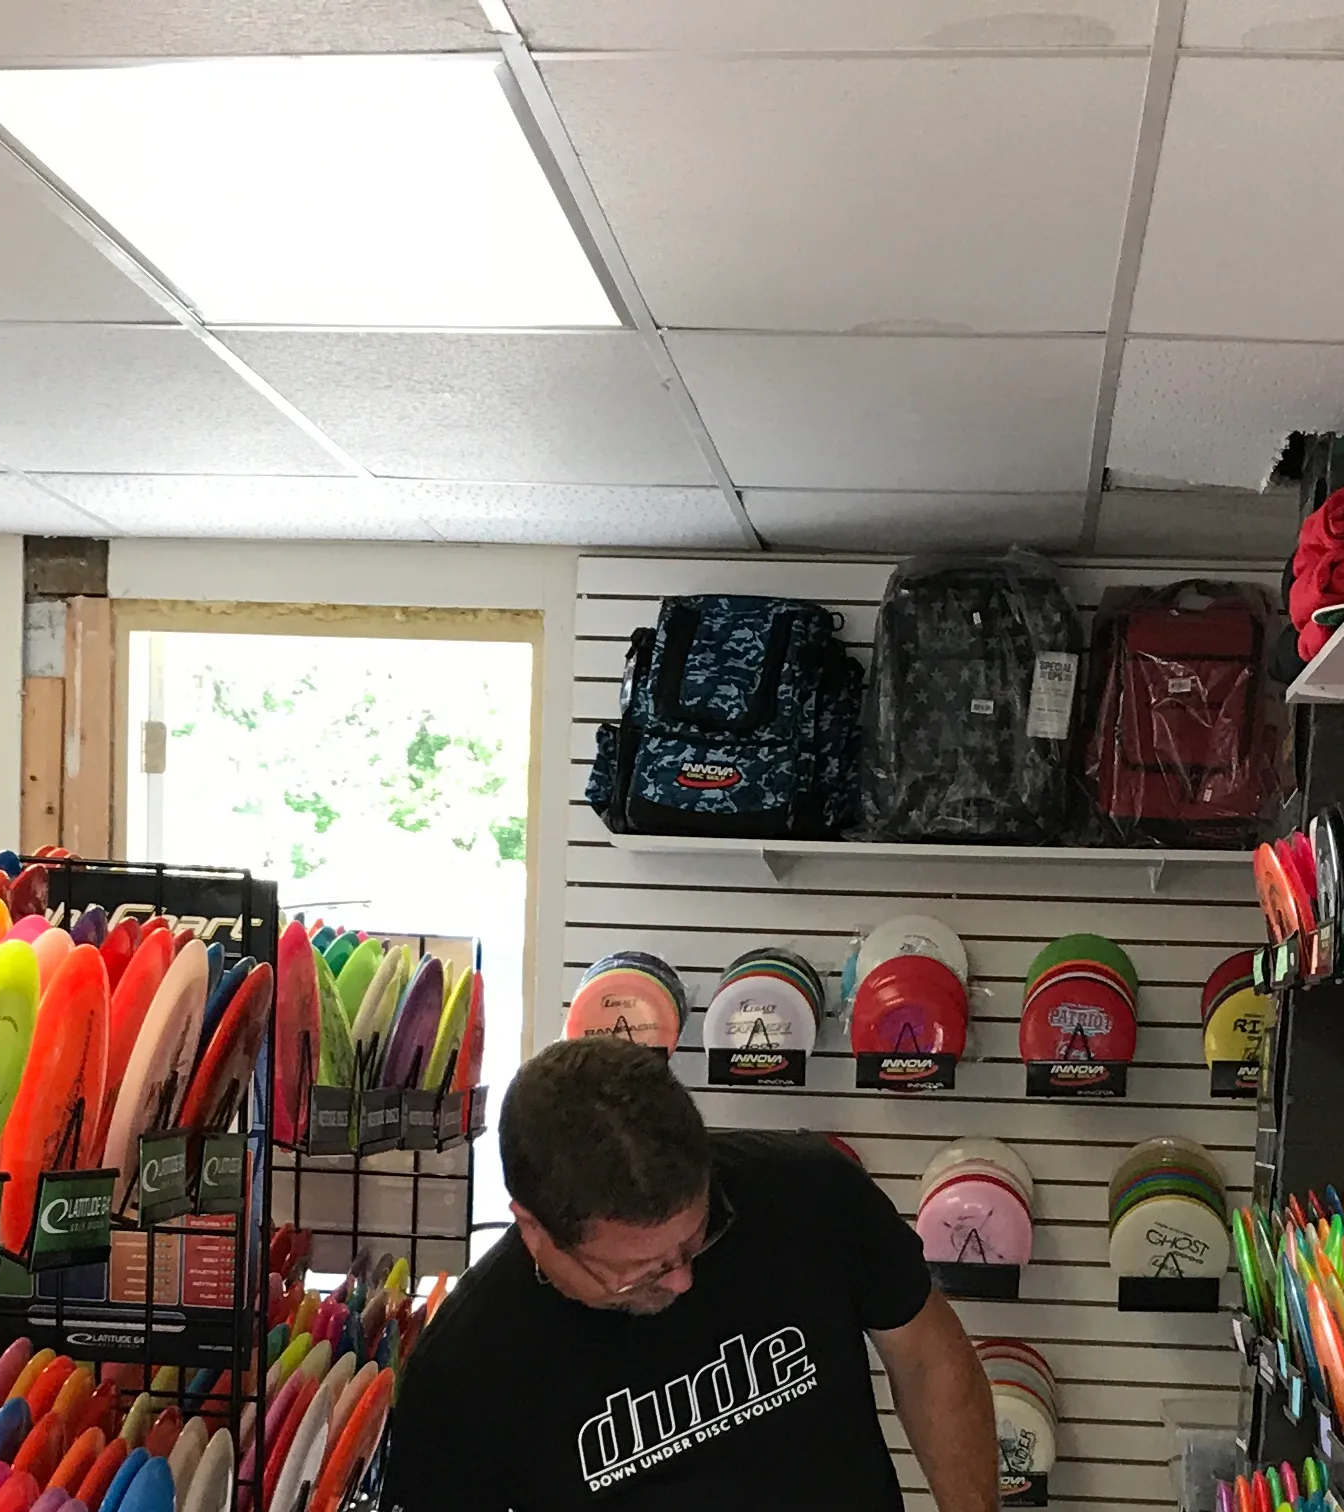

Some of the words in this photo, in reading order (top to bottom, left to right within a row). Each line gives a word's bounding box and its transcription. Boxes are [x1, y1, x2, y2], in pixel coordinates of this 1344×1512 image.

[682, 763, 734, 776] INNOVA
[730, 1054, 783, 1063] INNOVA
[881, 1059, 933, 1069] INNOVA
[1050, 1065, 1104, 1074] INNOVA
[68, 1198, 101, 1219] LATITUDE
[1145, 1228, 1210, 1257] GHOST
[92, 1333, 132, 1343] LATITUDE
[578, 1326, 816, 1481] dude
[589, 1463, 637, 1492] DOWN
[640, 1437, 692, 1469] UNDER
[695, 1419, 731, 1444] DISC
[735, 1377, 818, 1426] EVOLUTION
